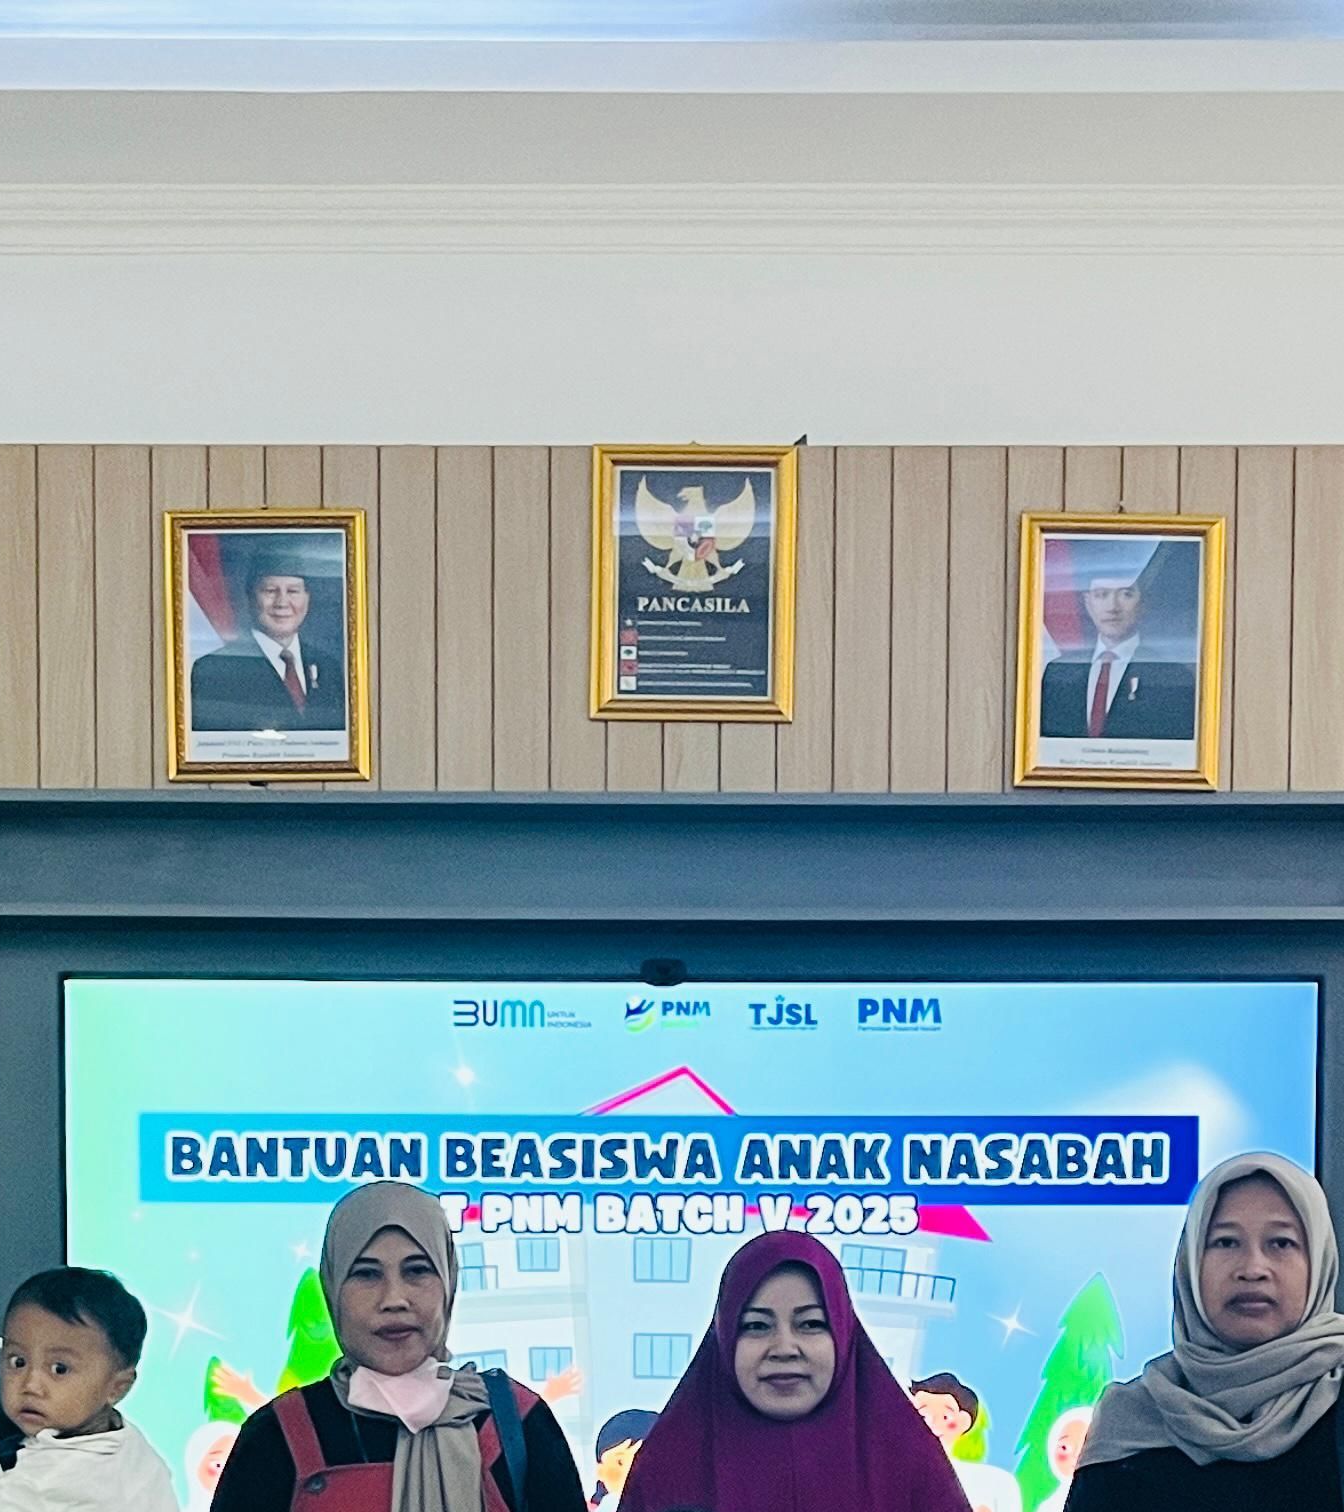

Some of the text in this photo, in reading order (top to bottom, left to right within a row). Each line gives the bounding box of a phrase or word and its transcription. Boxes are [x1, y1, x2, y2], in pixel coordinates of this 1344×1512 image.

[637, 597, 750, 613] PANCASILA
[661, 1001, 711, 1016] PNM
[748, 1002, 818, 1026] TJSL
[857, 998, 942, 1024] PNM
[168, 1134, 1168, 1182] BANTUAN BEASISWA ANAK NASABAH
[440, 1192, 920, 1234] T PNM BATCH V 2025
